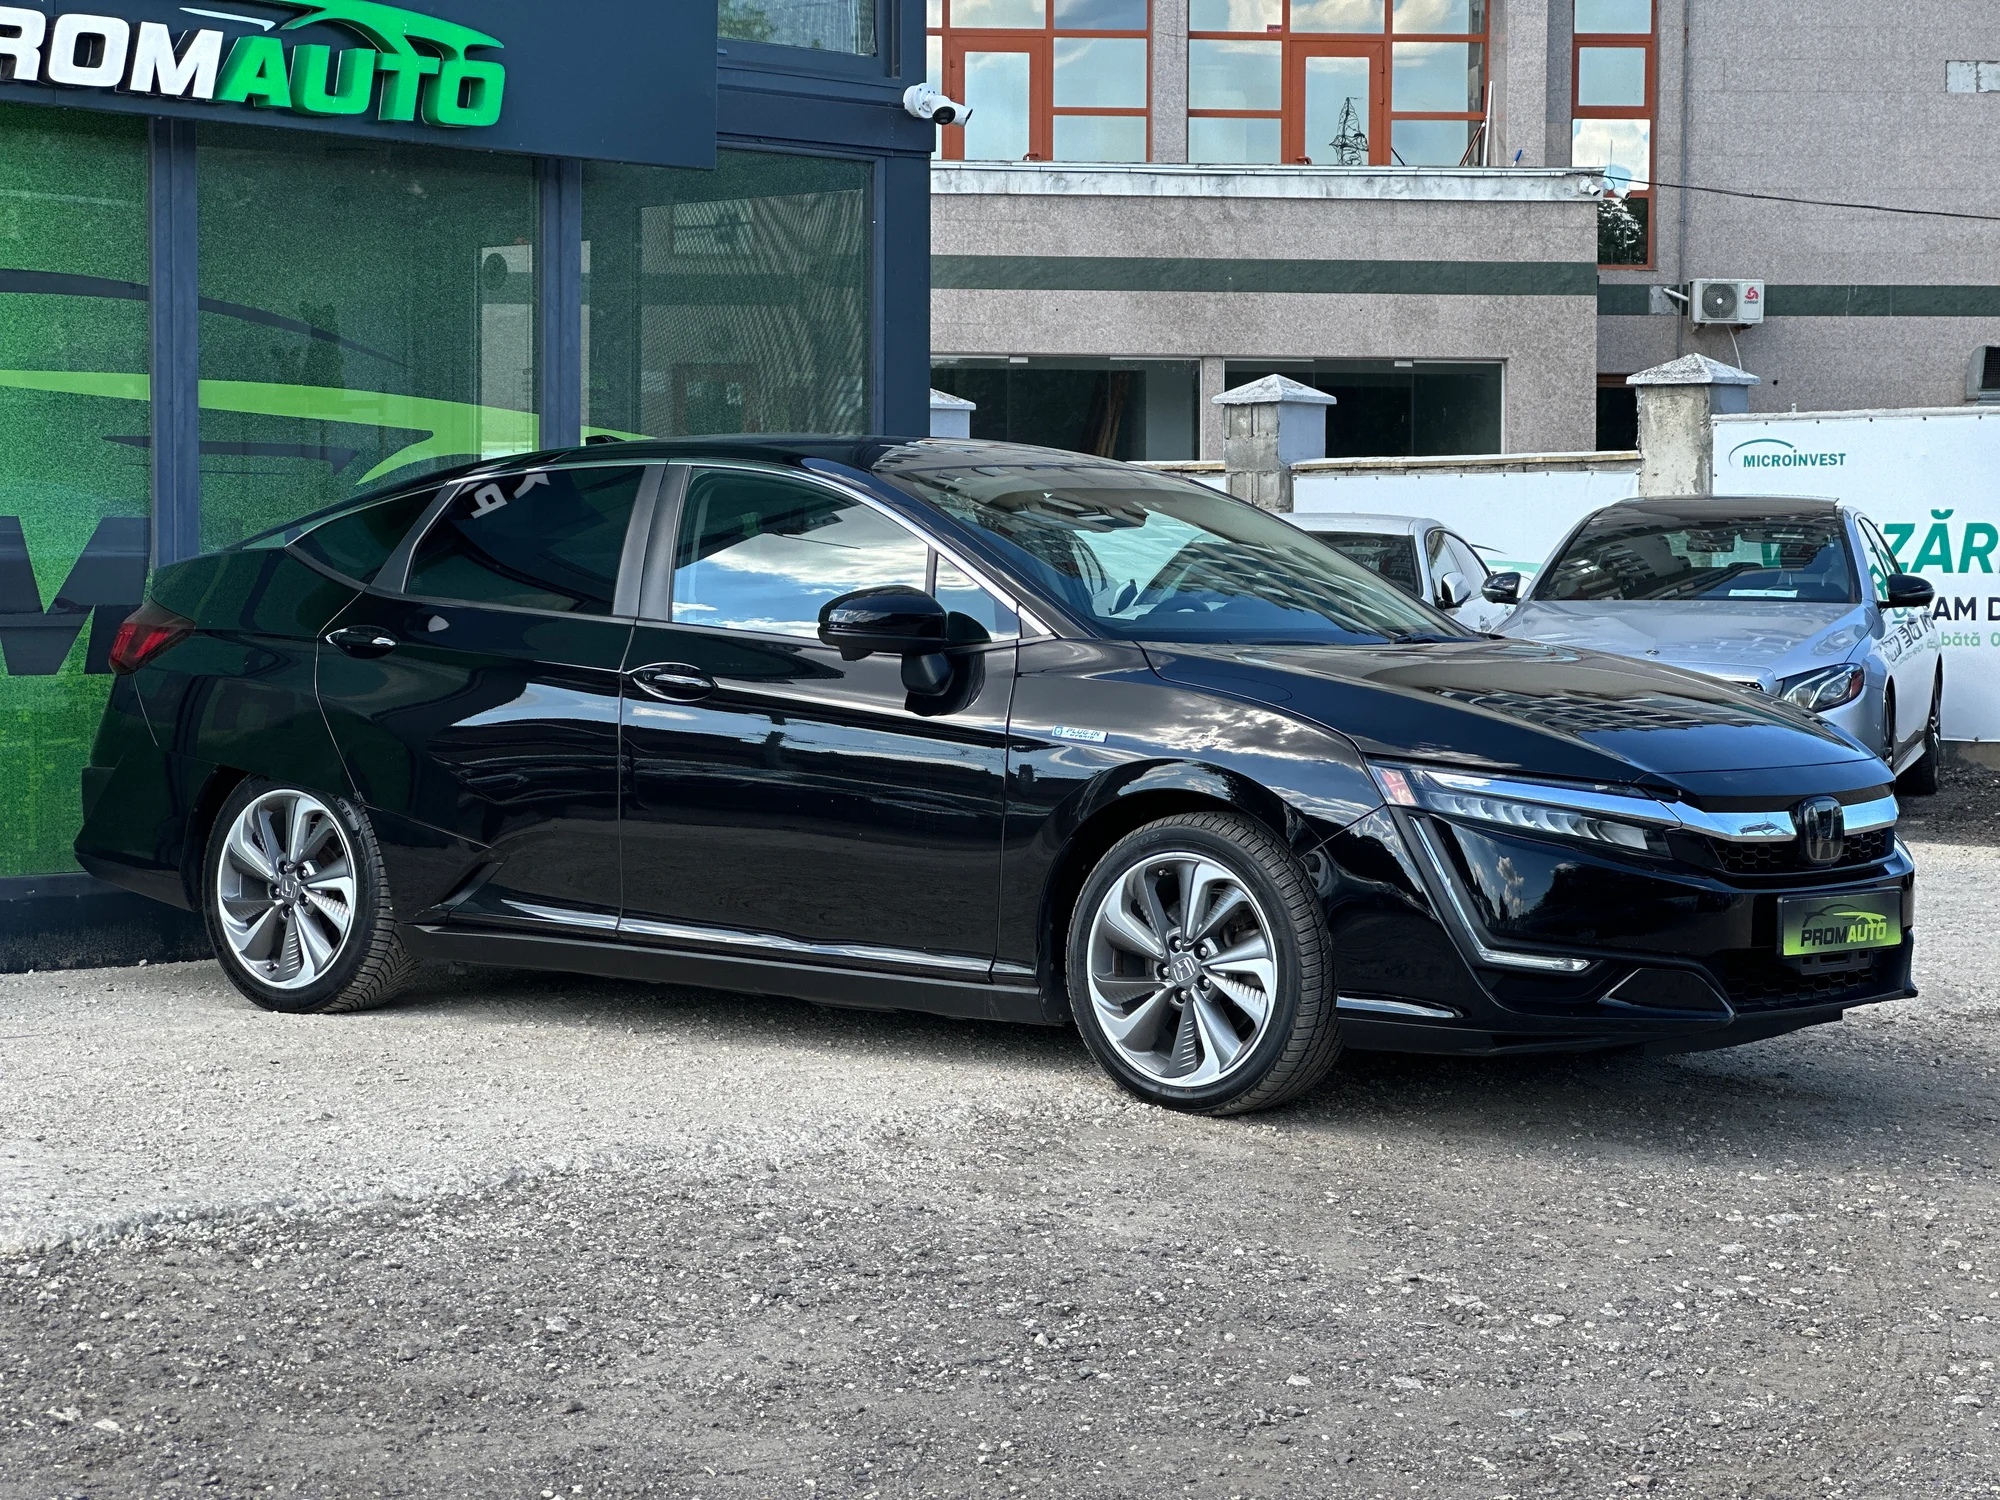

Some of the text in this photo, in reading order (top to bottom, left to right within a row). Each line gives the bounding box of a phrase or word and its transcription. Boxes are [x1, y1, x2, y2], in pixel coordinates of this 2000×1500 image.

[1880, 509, 2000, 573] ZĂR
[1932, 596, 1977, 621] AM
[1941, 631, 1981, 647] bătă
[1801, 922, 1887, 947] PROMAUTO
